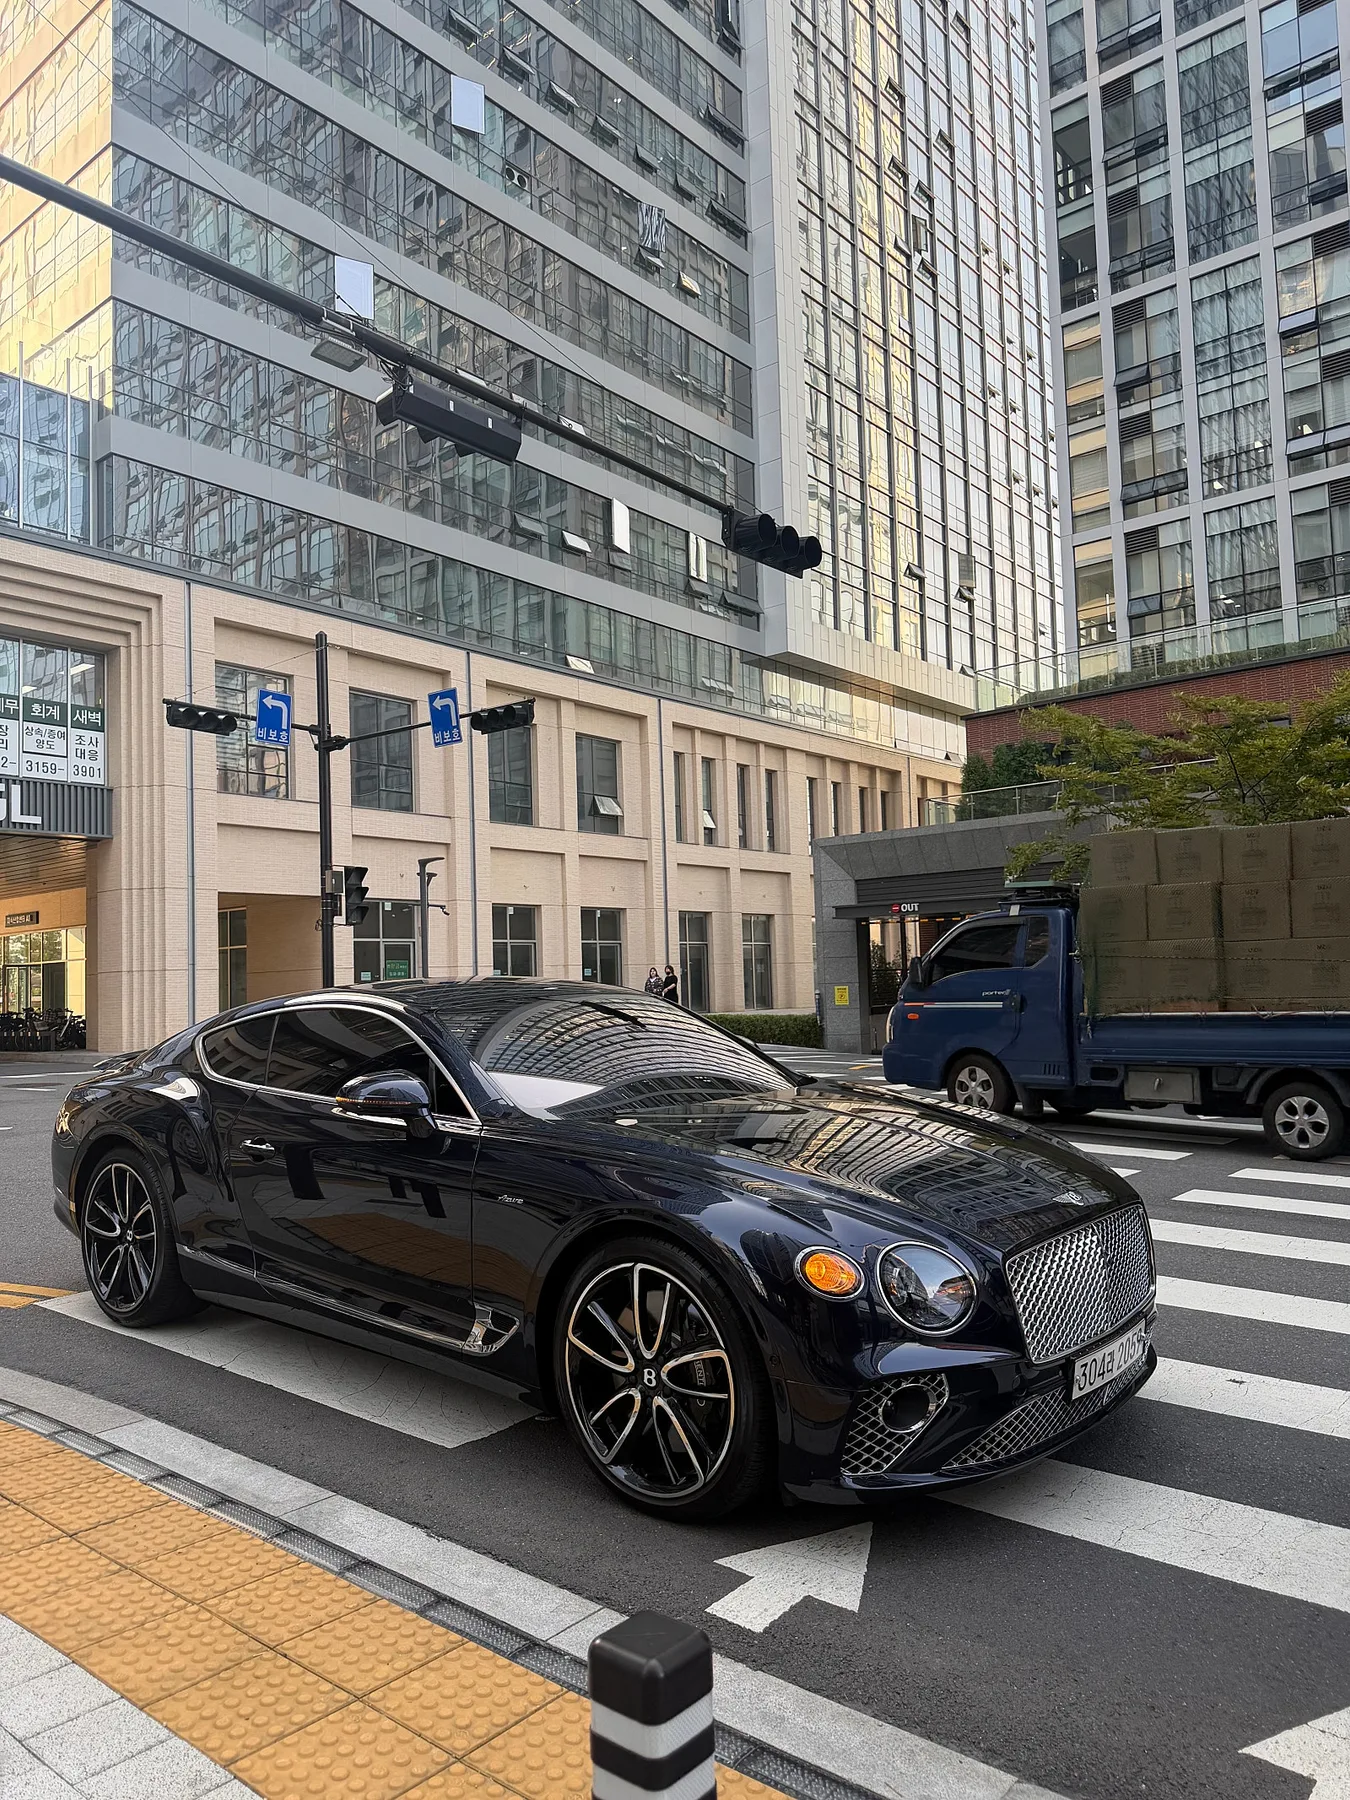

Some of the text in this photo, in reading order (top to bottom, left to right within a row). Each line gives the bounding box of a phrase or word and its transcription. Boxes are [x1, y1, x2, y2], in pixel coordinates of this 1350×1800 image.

[0, 697, 102, 727] 무 회계 새벽
[75, 734, 99, 748] 조사
[258, 727, 288, 743] 비보호
[434, 728, 460, 744] 비보호
[35, 738, 55, 750] 양도
[75, 748, 99, 762] 대응
[25, 759, 65, 775] 3159-
[73, 764, 101, 779] 3901
[900, 903, 919, 912] OUT
[643, 1368, 657, 1387] B
[1077, 1350, 1115, 1391] 304라
